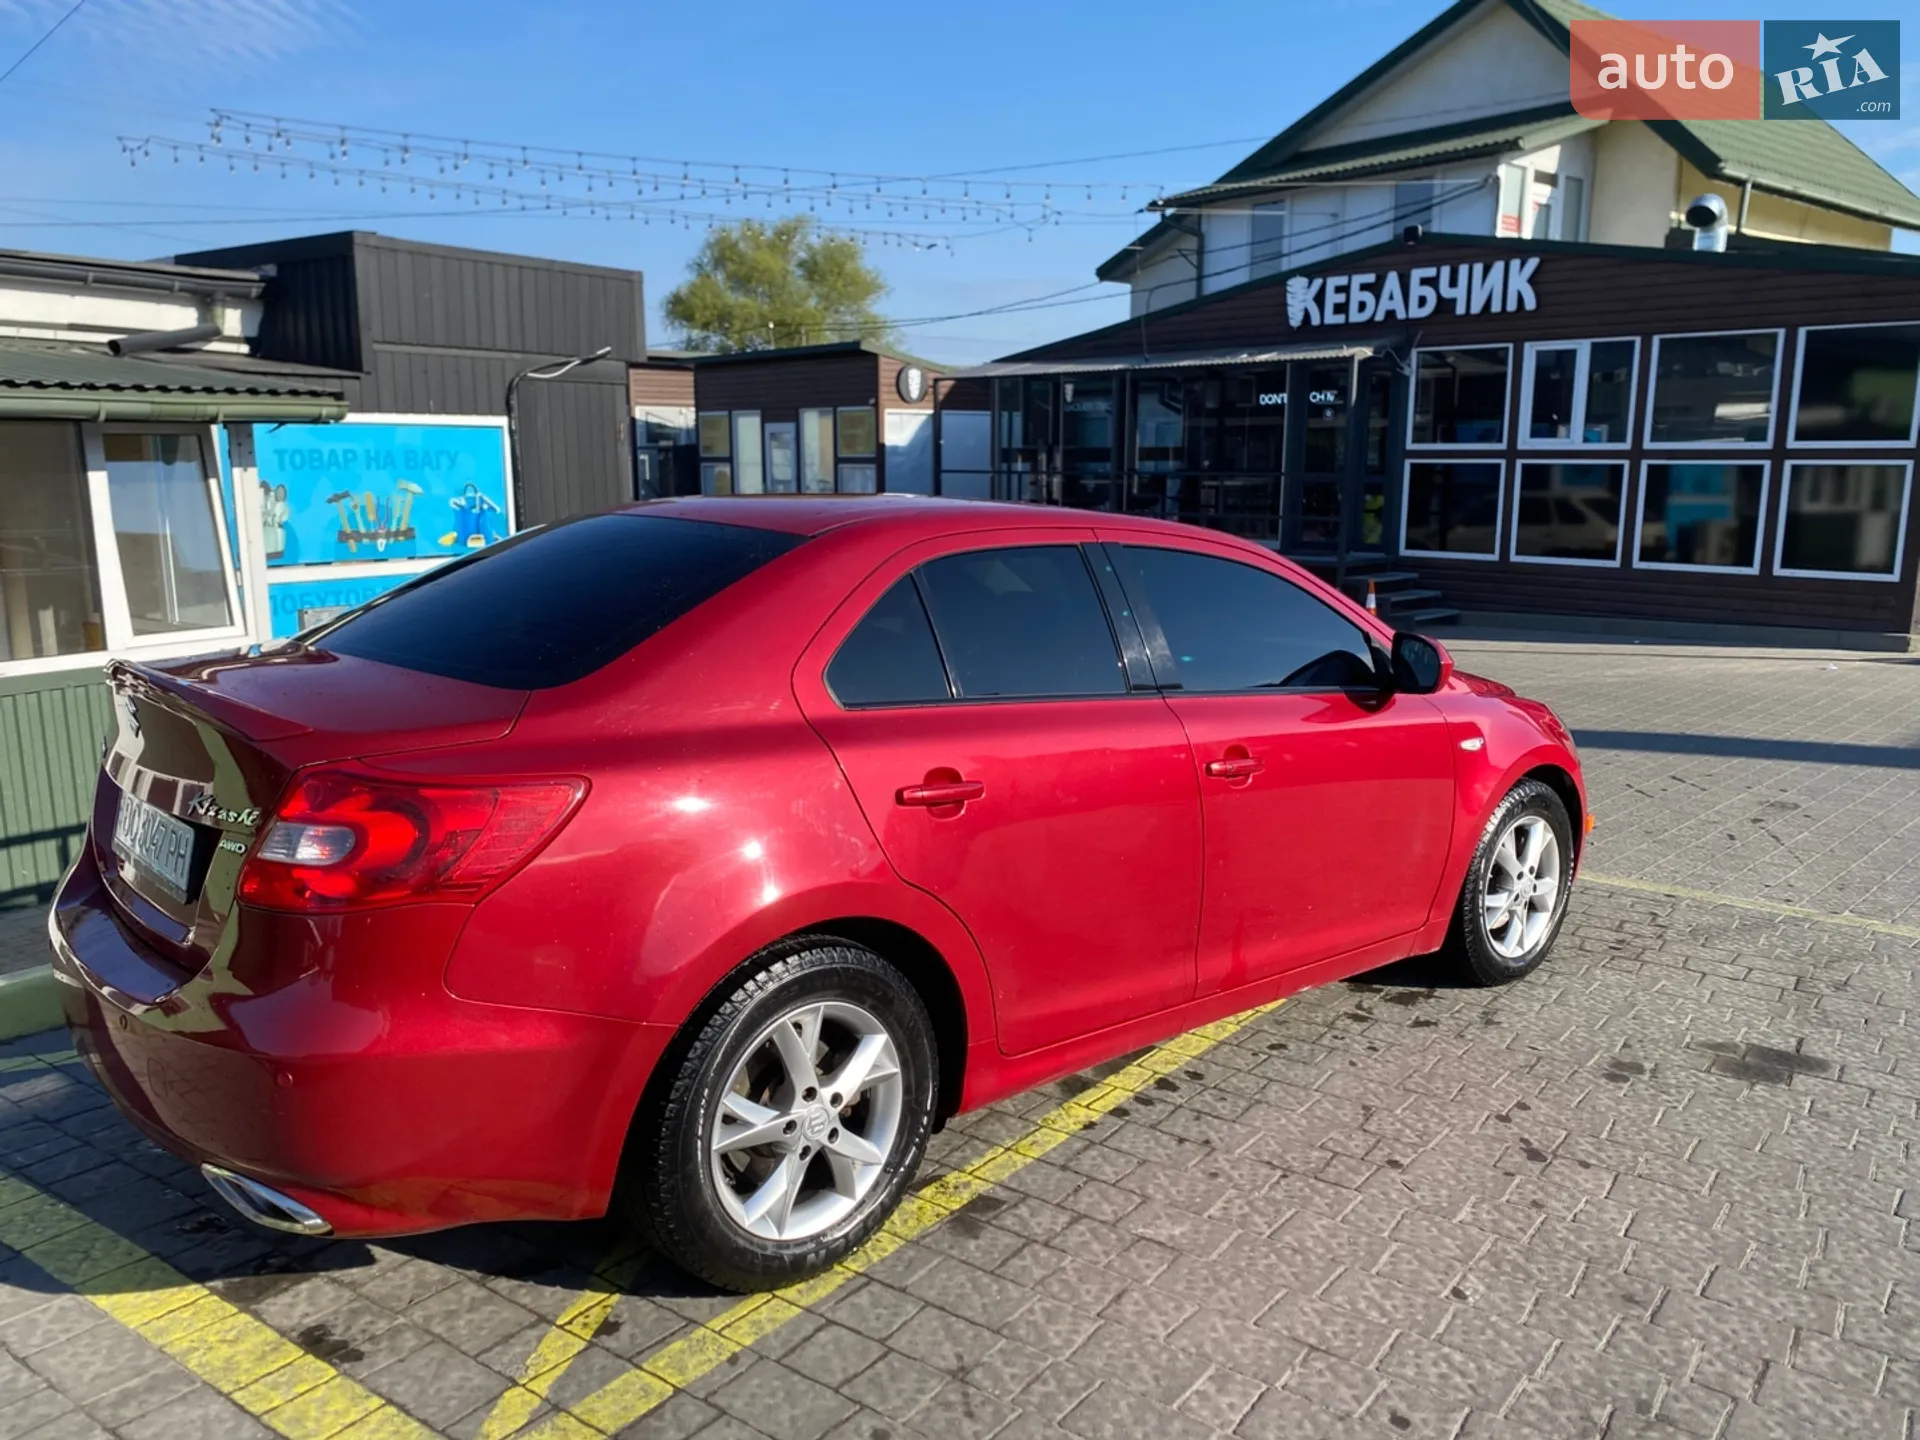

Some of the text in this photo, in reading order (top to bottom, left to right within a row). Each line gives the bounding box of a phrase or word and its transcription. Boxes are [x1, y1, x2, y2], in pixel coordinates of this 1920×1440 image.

[1286, 257, 1541, 330] КЕБАБЧИК
[273, 448, 461, 472] ТОВАР НА ВАГУ
